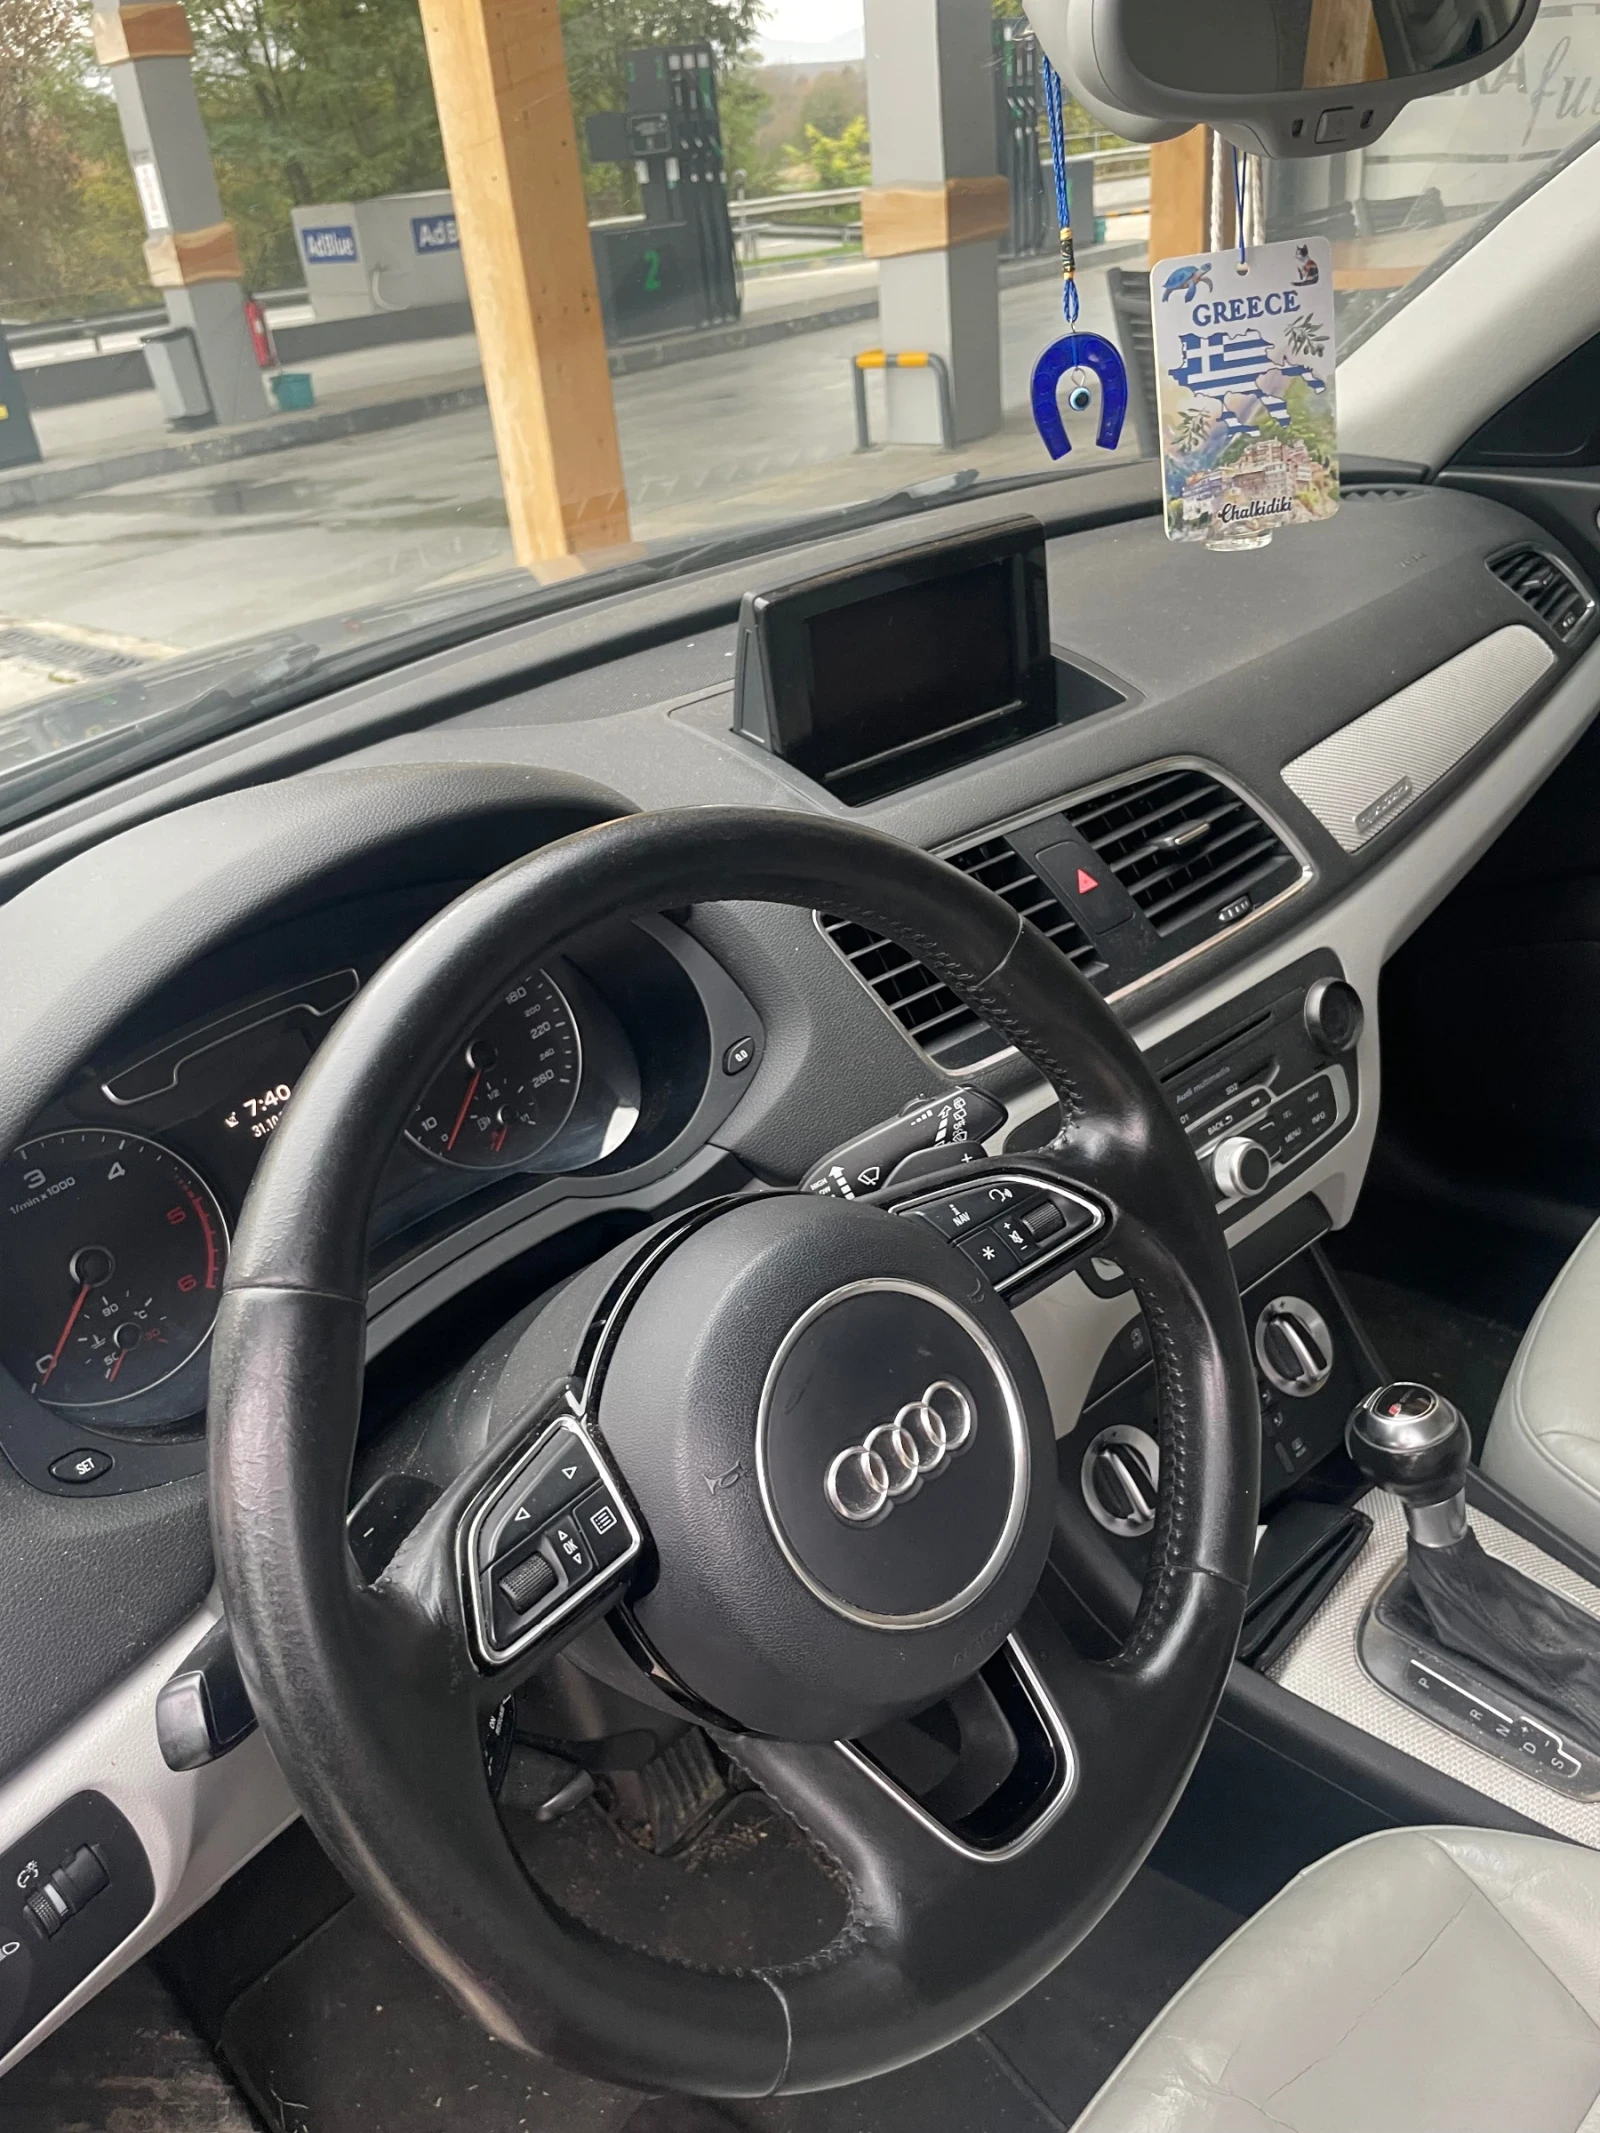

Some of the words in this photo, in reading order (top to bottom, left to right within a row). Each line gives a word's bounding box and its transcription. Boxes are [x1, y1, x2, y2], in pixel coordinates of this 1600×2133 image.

[418, 220, 461, 249] AdB
[306, 232, 355, 258] AdBlue
[643, 250, 662, 292] 2
[1192, 290, 1301, 327] GREECE
[1217, 496, 1293, 524] Chalkidiki
[505, 986, 527, 1005] 180
[523, 1003, 541, 1018] 200
[530, 1021, 551, 1040] 220
[532, 1069, 555, 1088] 260
[242, 1084, 292, 1117] 7:40
[421, 1116, 438, 1132] 10
[23, 1168, 47, 1190] 3
[108, 1161, 126, 1181] 4
[818, 1185, 831, 1196] OW
[166, 1205, 187, 1226] 5
[952, 1211, 971, 1227] NAV
[177, 1274, 198, 1293] 6
[102, 1302, 119, 1317] 90
[75, 1456, 95, 1475] SET
[563, 1537, 578, 1555] OK
[1418, 1676, 1430, 1690] P
[1469, 1707, 1484, 1722] R
[1495, 1722, 1512, 1738] N
[1522, 1741, 1537, 1755] D
[1550, 1756, 1565, 1770] S
